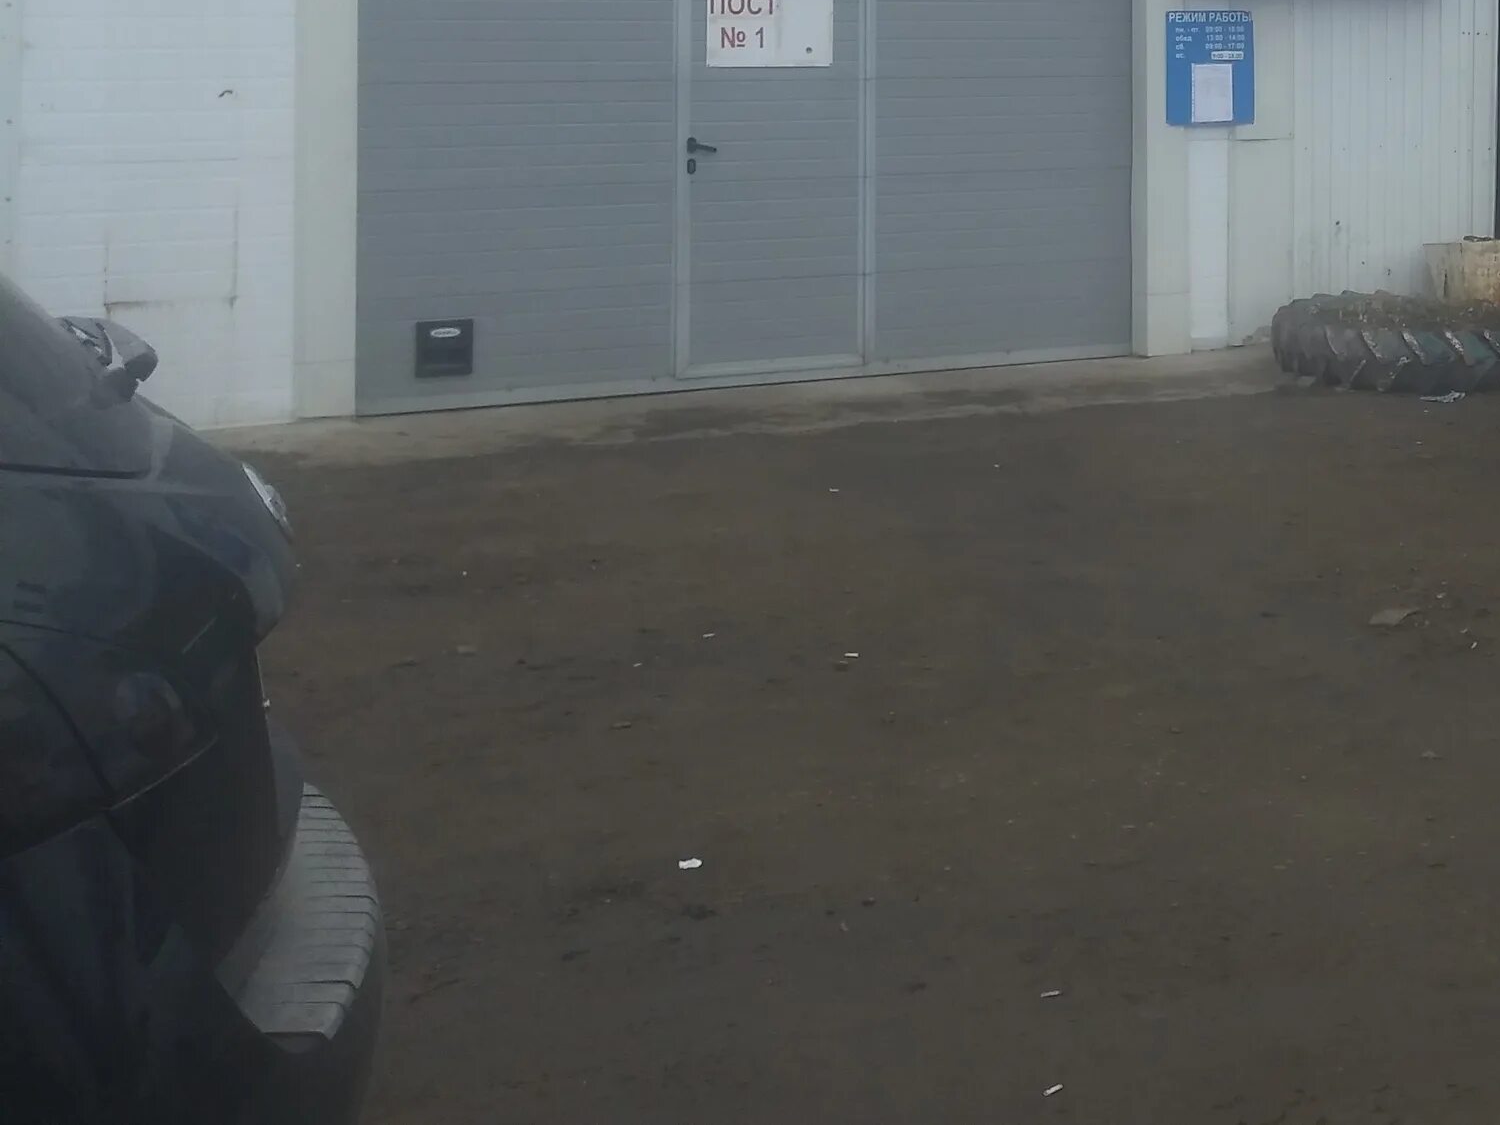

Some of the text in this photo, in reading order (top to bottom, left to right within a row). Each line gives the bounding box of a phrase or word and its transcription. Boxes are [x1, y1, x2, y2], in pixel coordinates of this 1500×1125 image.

[1168, 12, 1253, 23] РЕЖИМ РАБОТЫ
[720, 26, 764, 49] № 1
